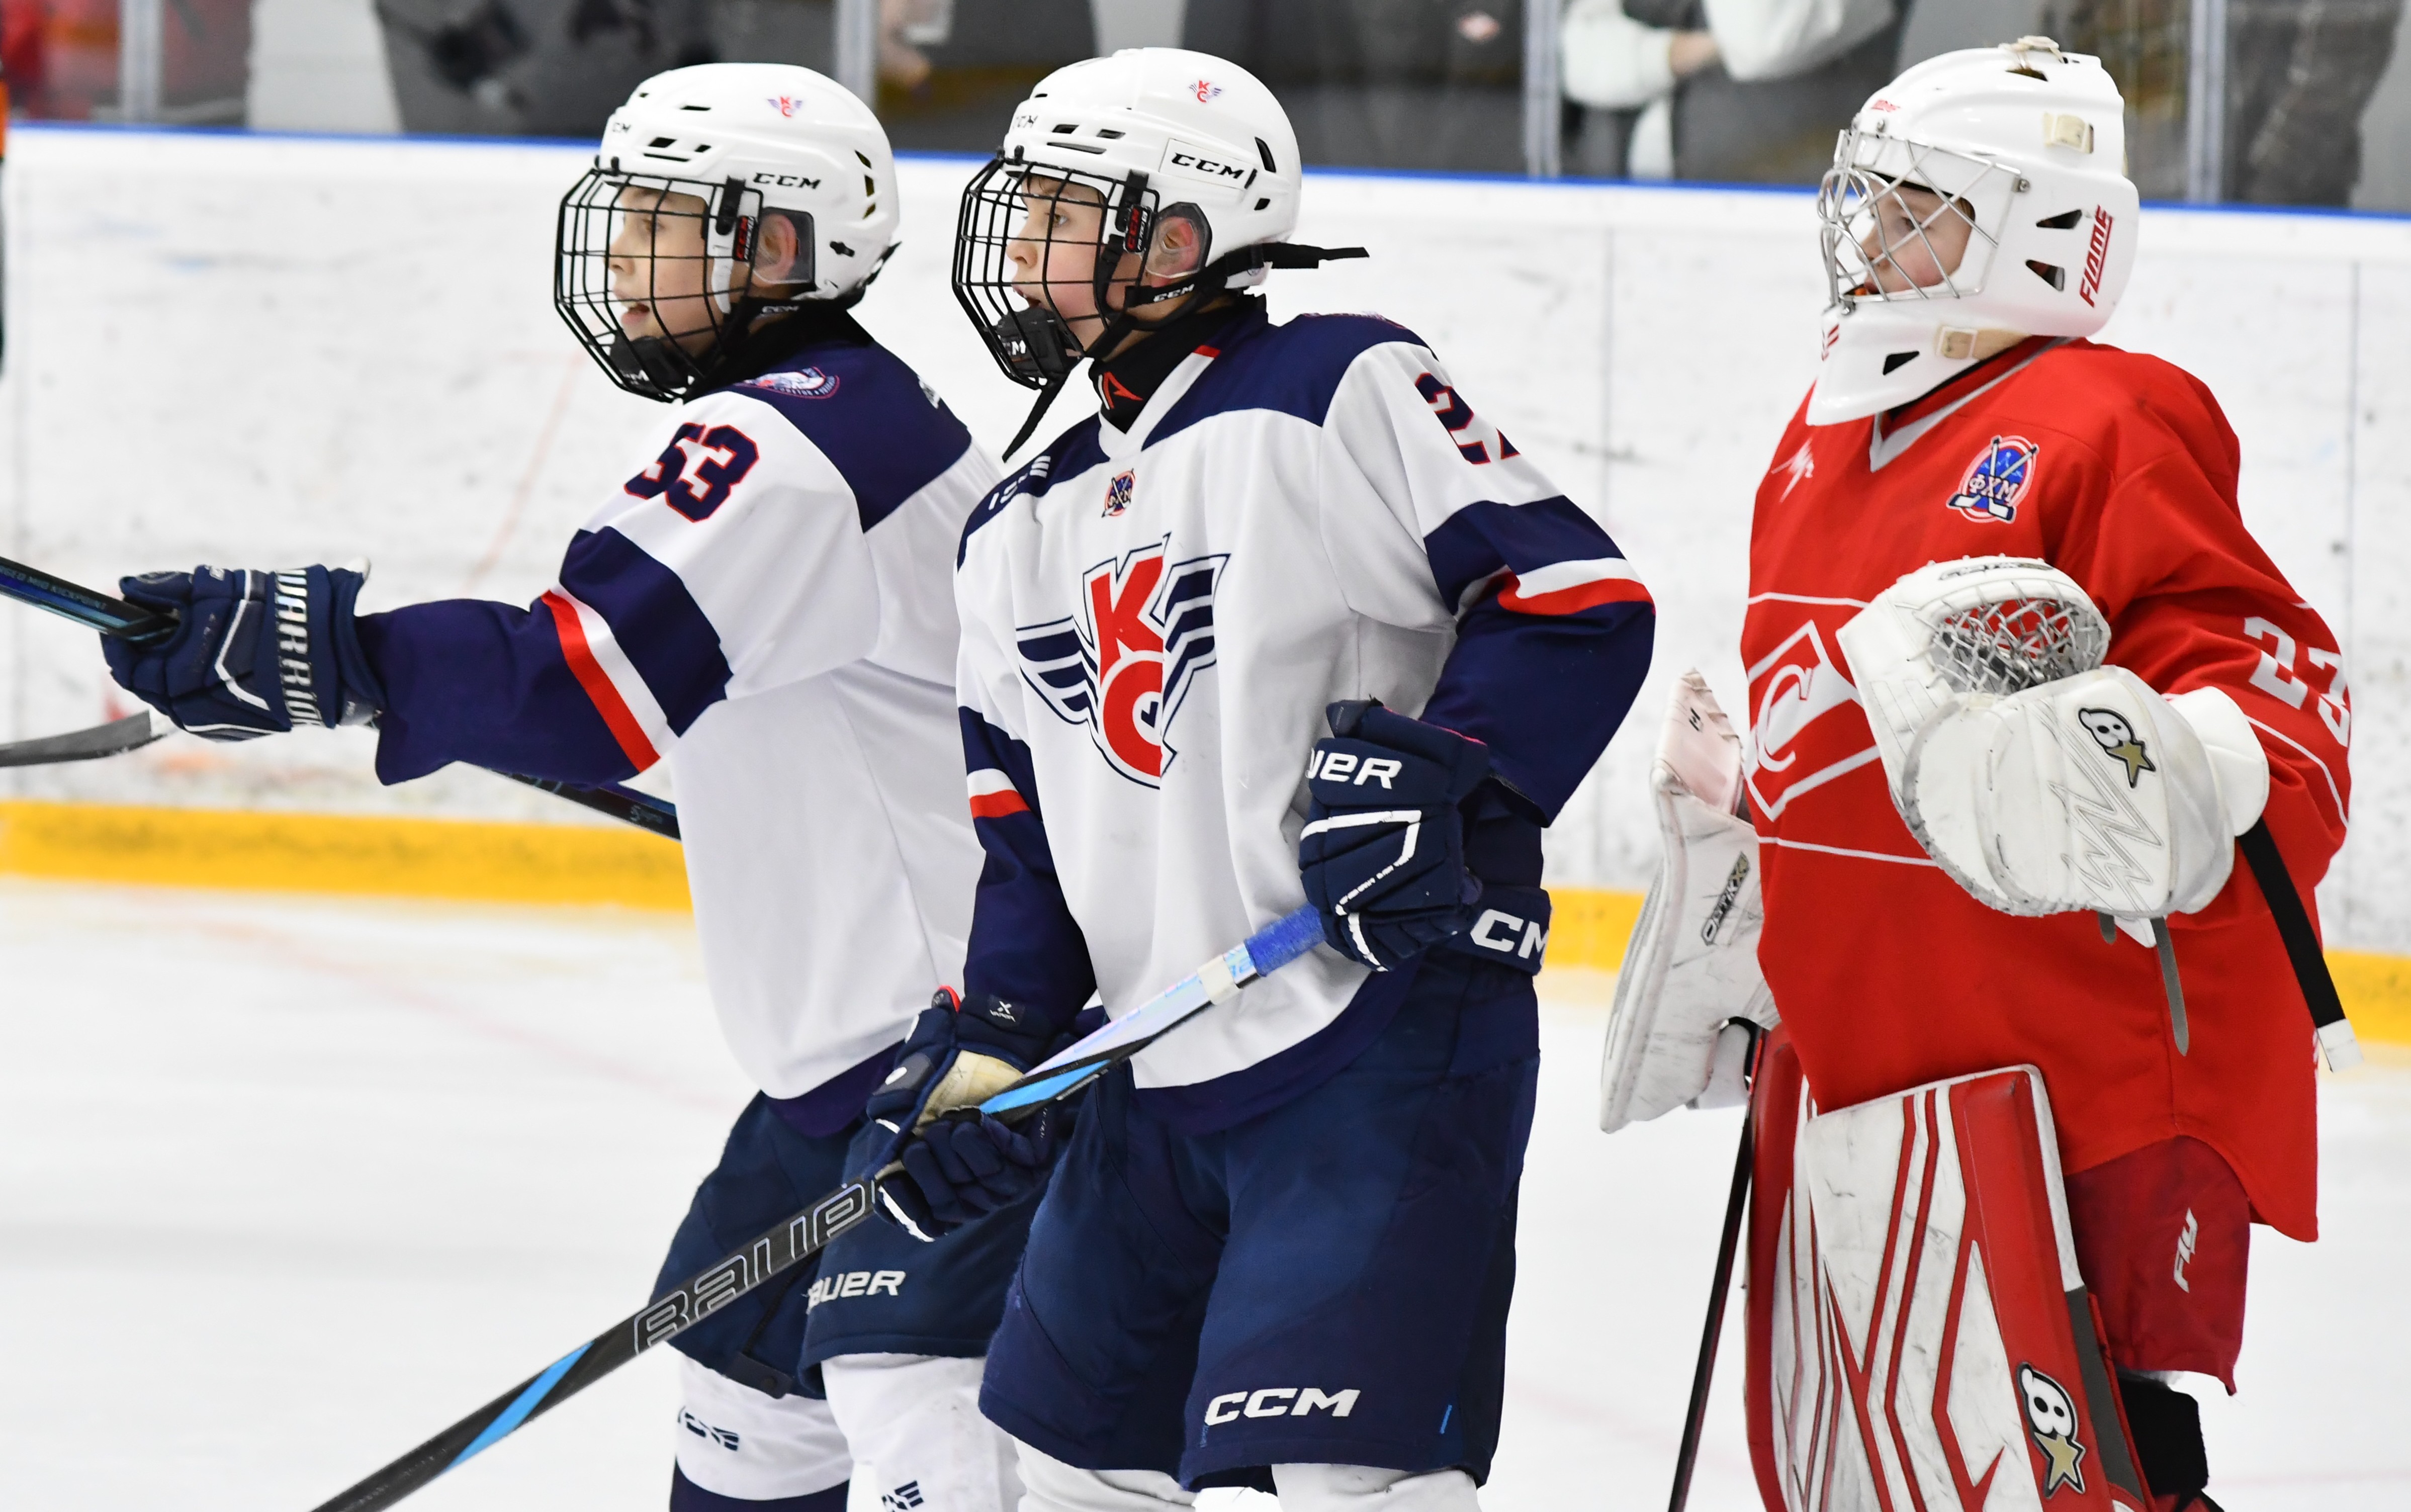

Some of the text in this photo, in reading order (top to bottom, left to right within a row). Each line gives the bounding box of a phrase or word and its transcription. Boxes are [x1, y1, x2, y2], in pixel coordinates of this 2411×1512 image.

[753, 172, 821, 190] CCM
[1171, 152, 1245, 179] CCM
[1153, 283, 1195, 302] CCM
[623, 422, 760, 523] 53
[1968, 473, 2019, 502] ФХМ
[2244, 616, 2354, 748] 23
[1470, 908, 1550, 966] CM
[806, 1270, 907, 1315] AUER
[1204, 1388, 1361, 1426] CCM
